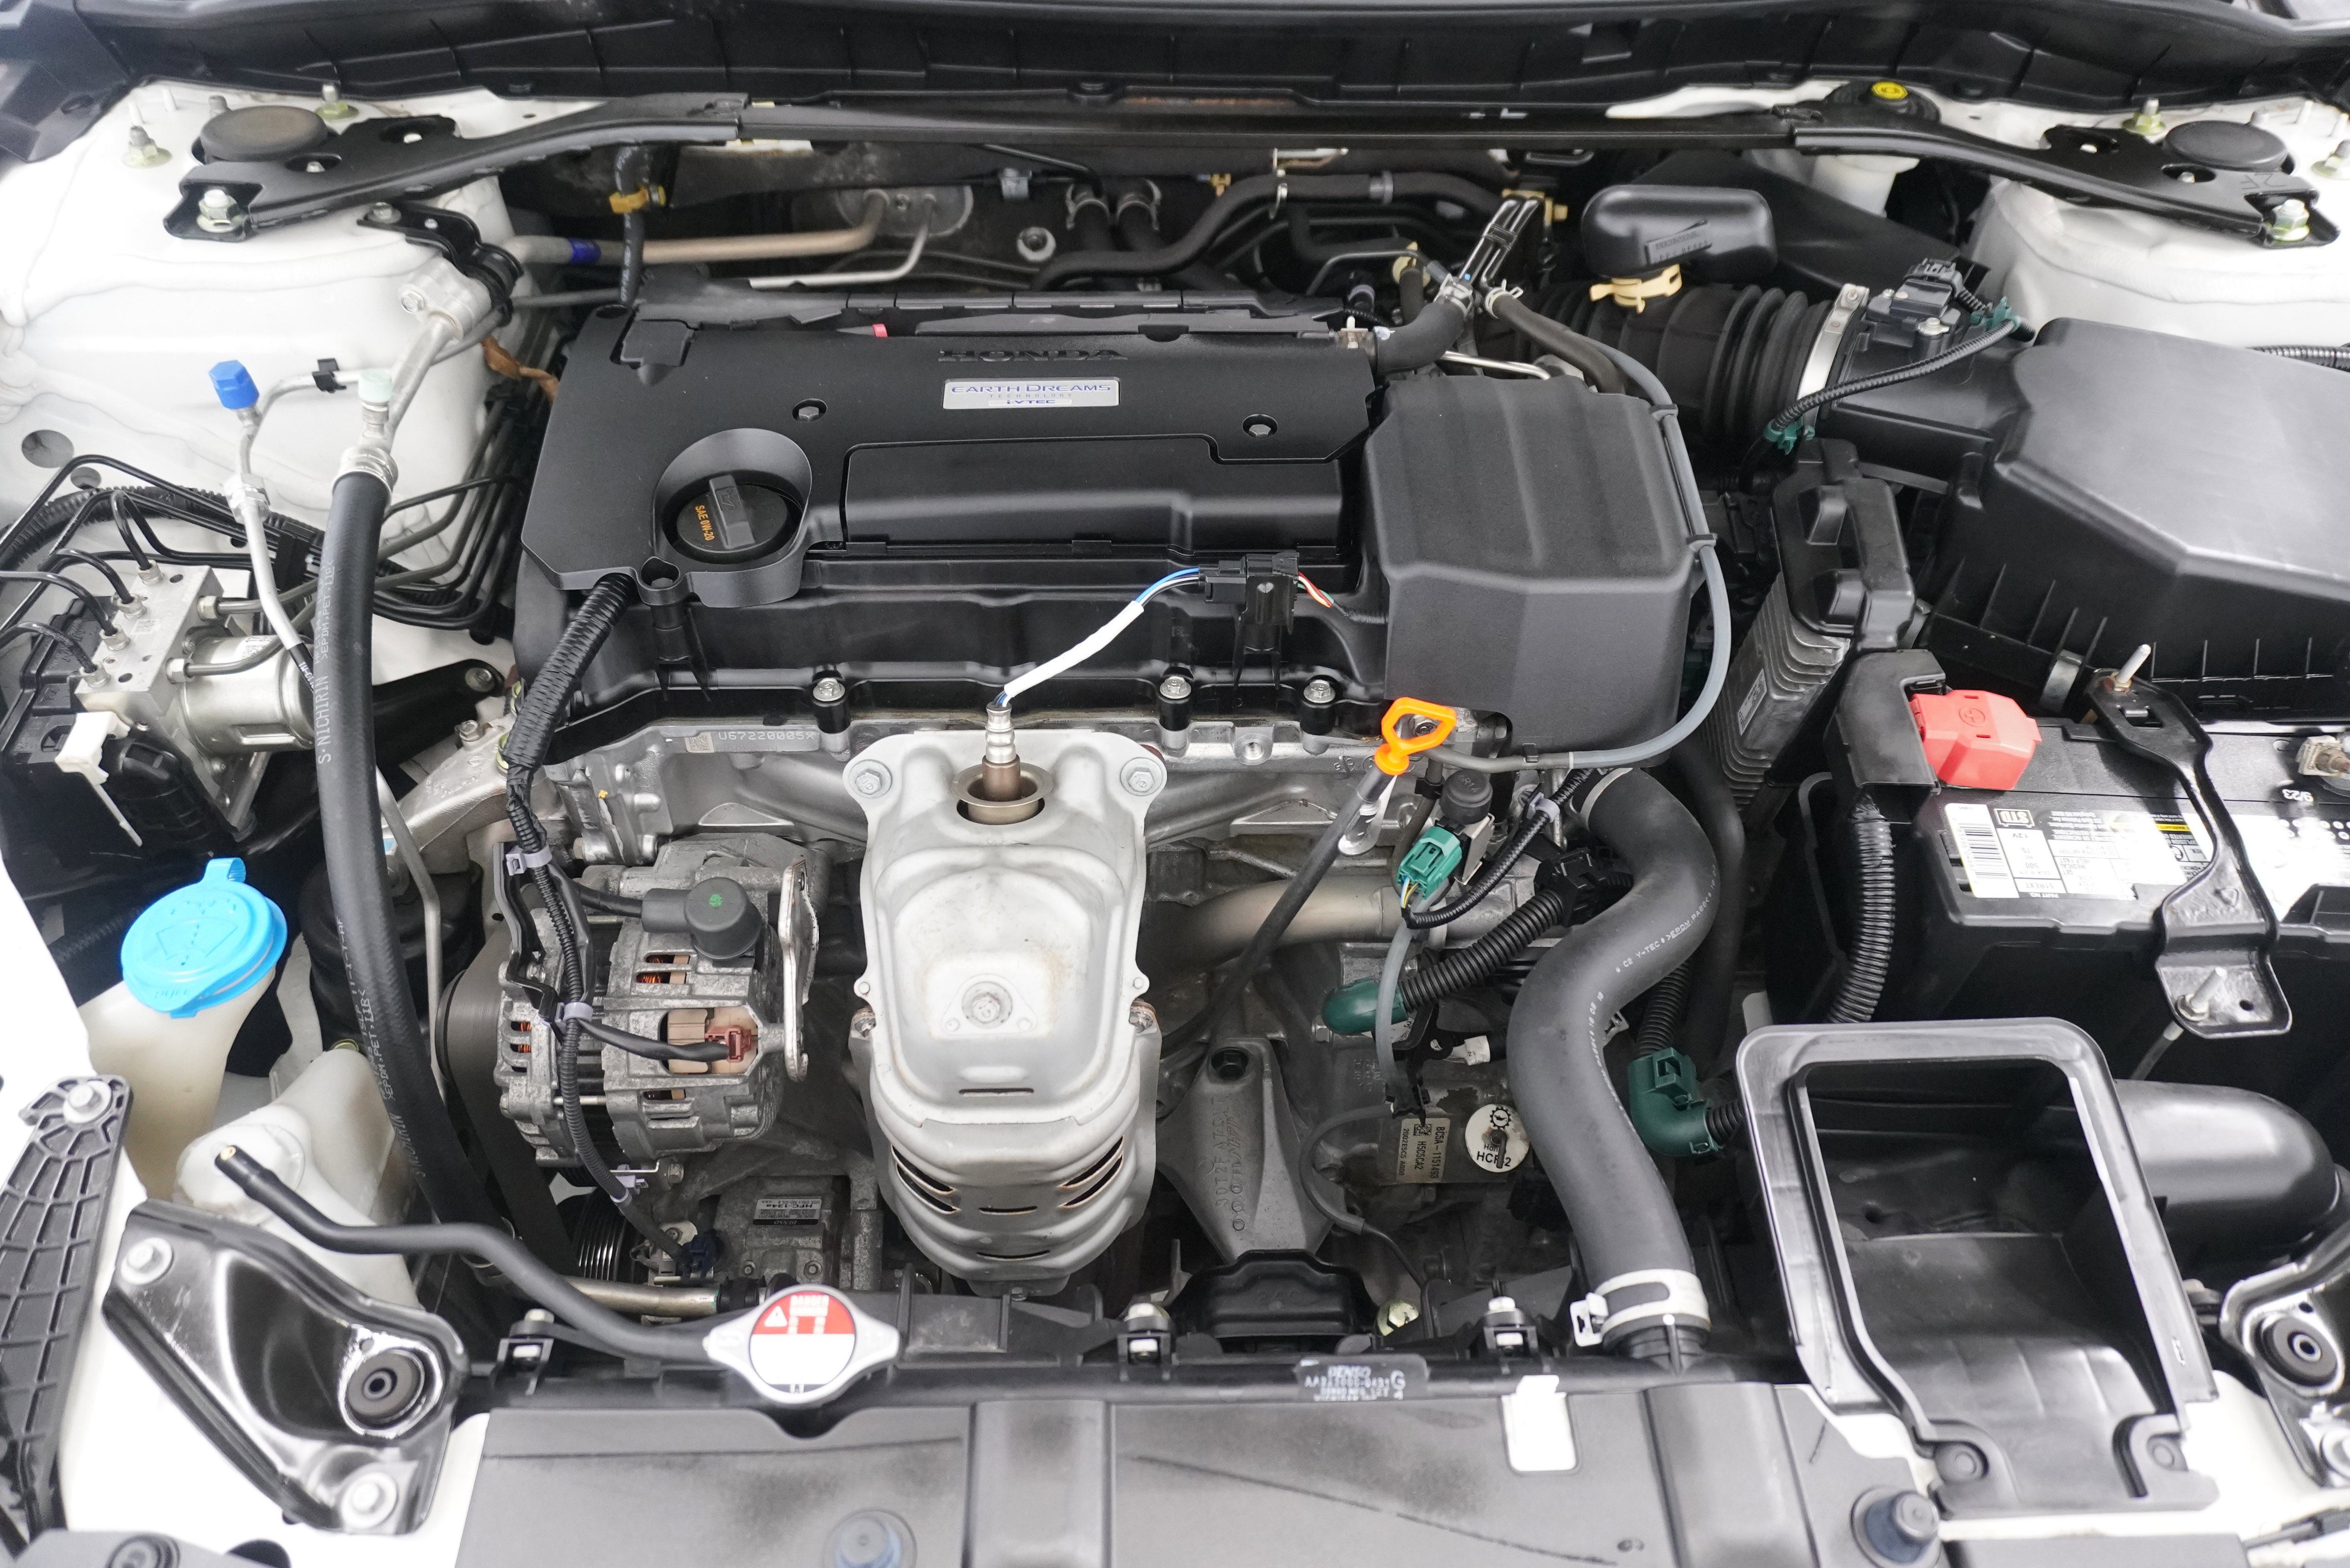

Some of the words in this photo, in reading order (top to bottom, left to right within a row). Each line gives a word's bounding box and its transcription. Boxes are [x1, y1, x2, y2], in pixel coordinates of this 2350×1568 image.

[938, 350, 1128, 362] HONDA
[695, 505, 708, 520] SAE
[700, 520, 715, 541] 0W-20
[2282, 789, 2314, 802] 9/23
[1999, 811, 2029, 823] STD
[1476, 1151, 1512, 1167] HCF2
